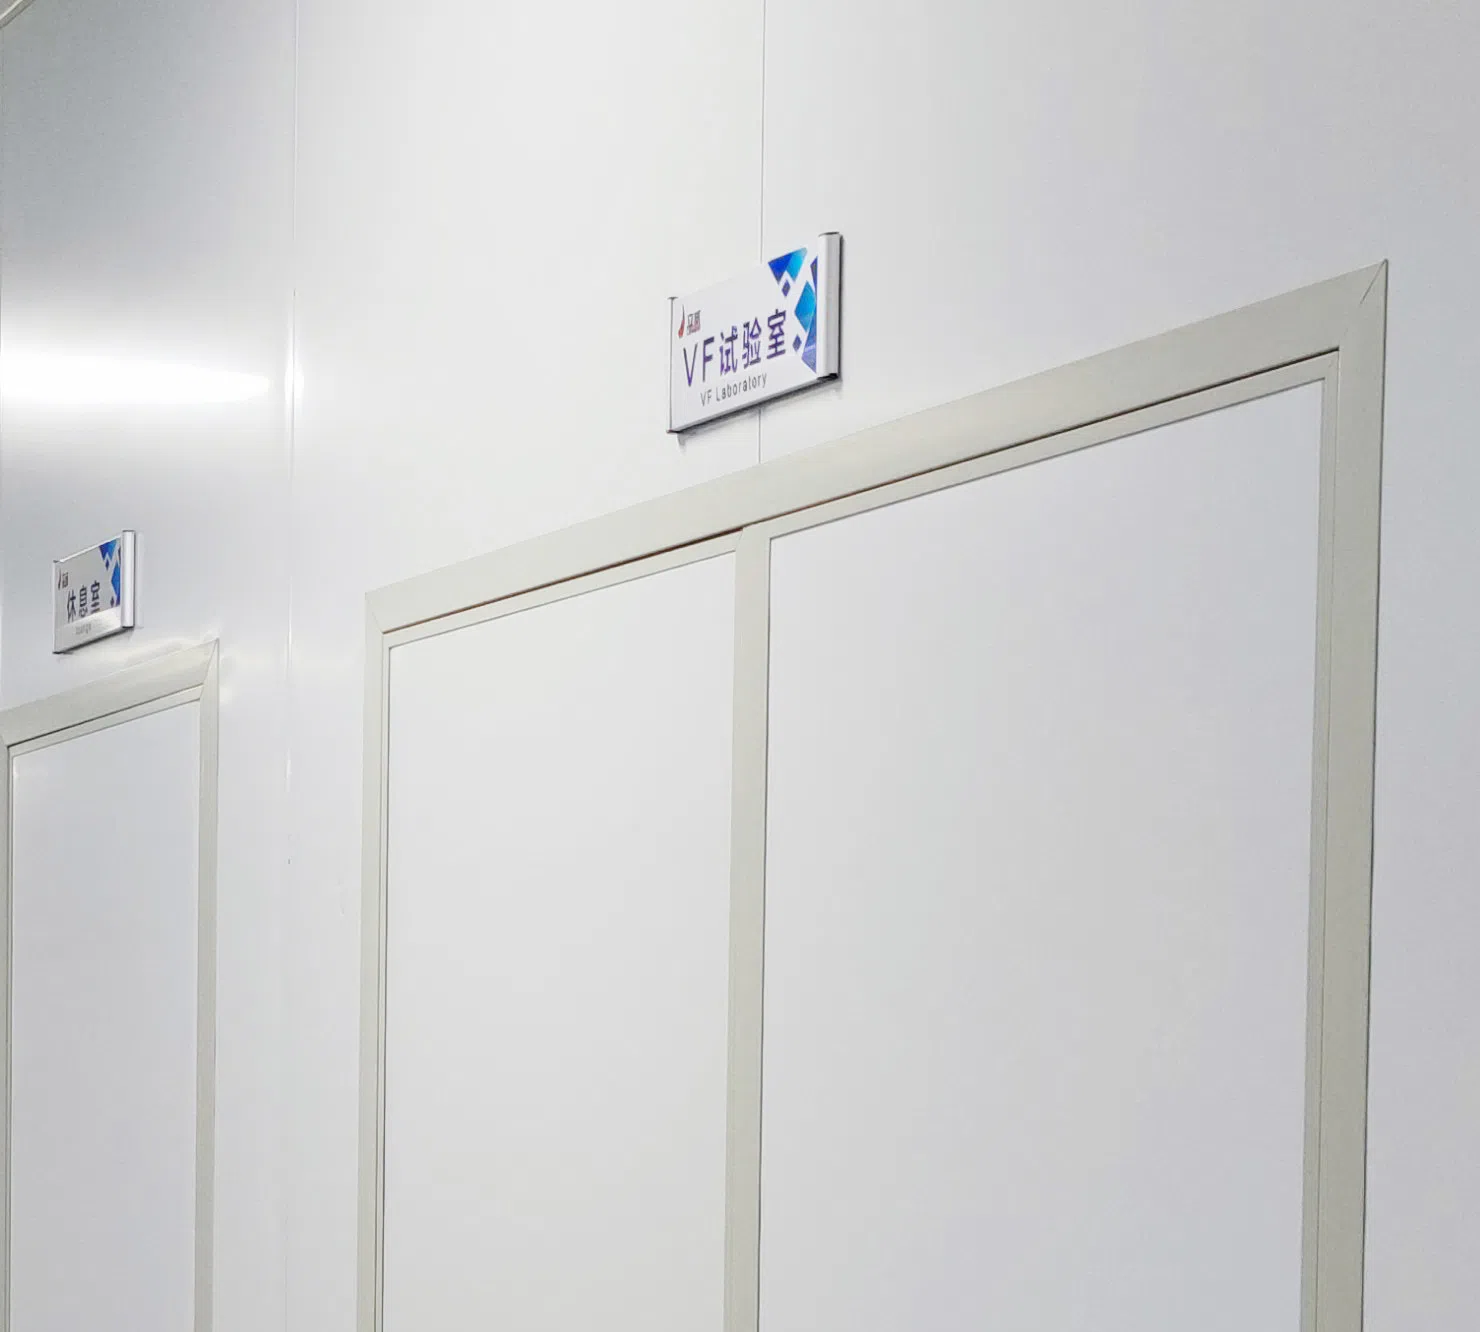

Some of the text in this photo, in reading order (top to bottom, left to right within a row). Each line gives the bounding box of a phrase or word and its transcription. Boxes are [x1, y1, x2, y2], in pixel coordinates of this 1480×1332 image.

[683, 308, 786, 387] VF试验室
[700, 373, 767, 406] VF Laboratory
[67, 579, 100, 623] 休息室
